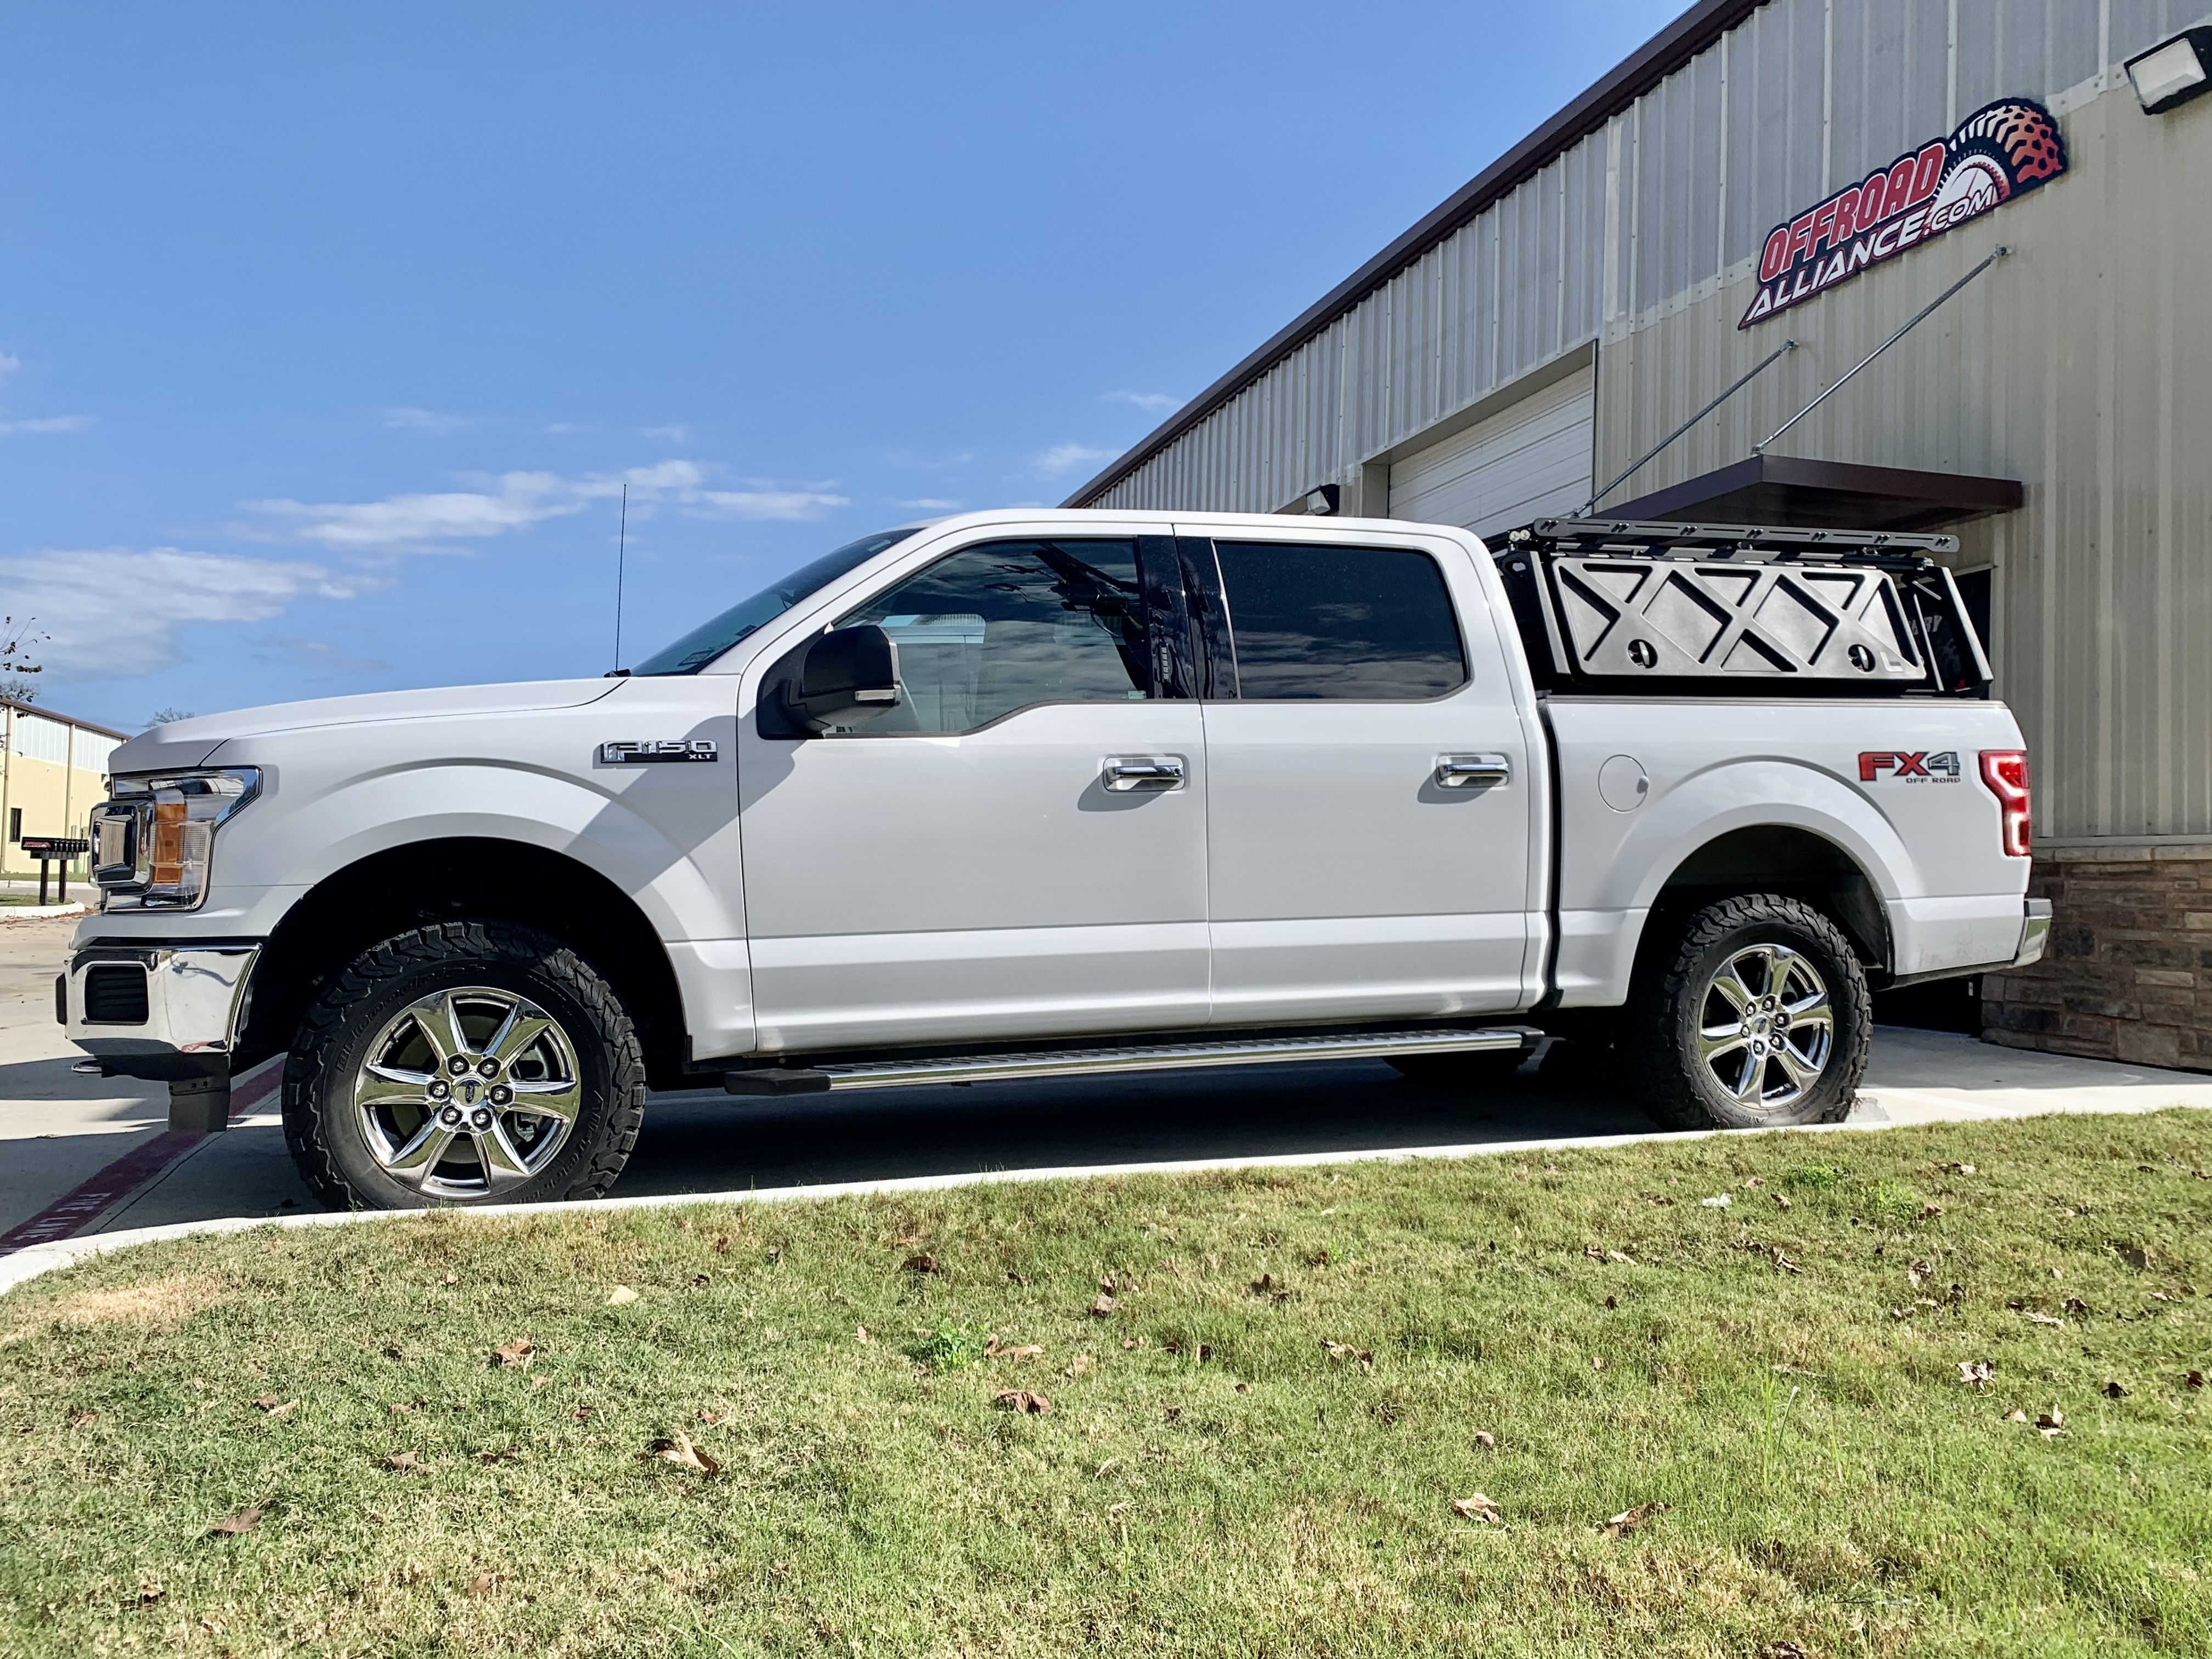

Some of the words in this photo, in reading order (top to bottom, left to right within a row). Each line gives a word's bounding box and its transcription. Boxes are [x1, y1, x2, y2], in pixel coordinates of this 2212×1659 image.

[1746, 184, 1998, 322] ALLIANCE.COM
[1759, 142, 1946, 283] OFFROAD
[1858, 752, 1960, 781] FX4
